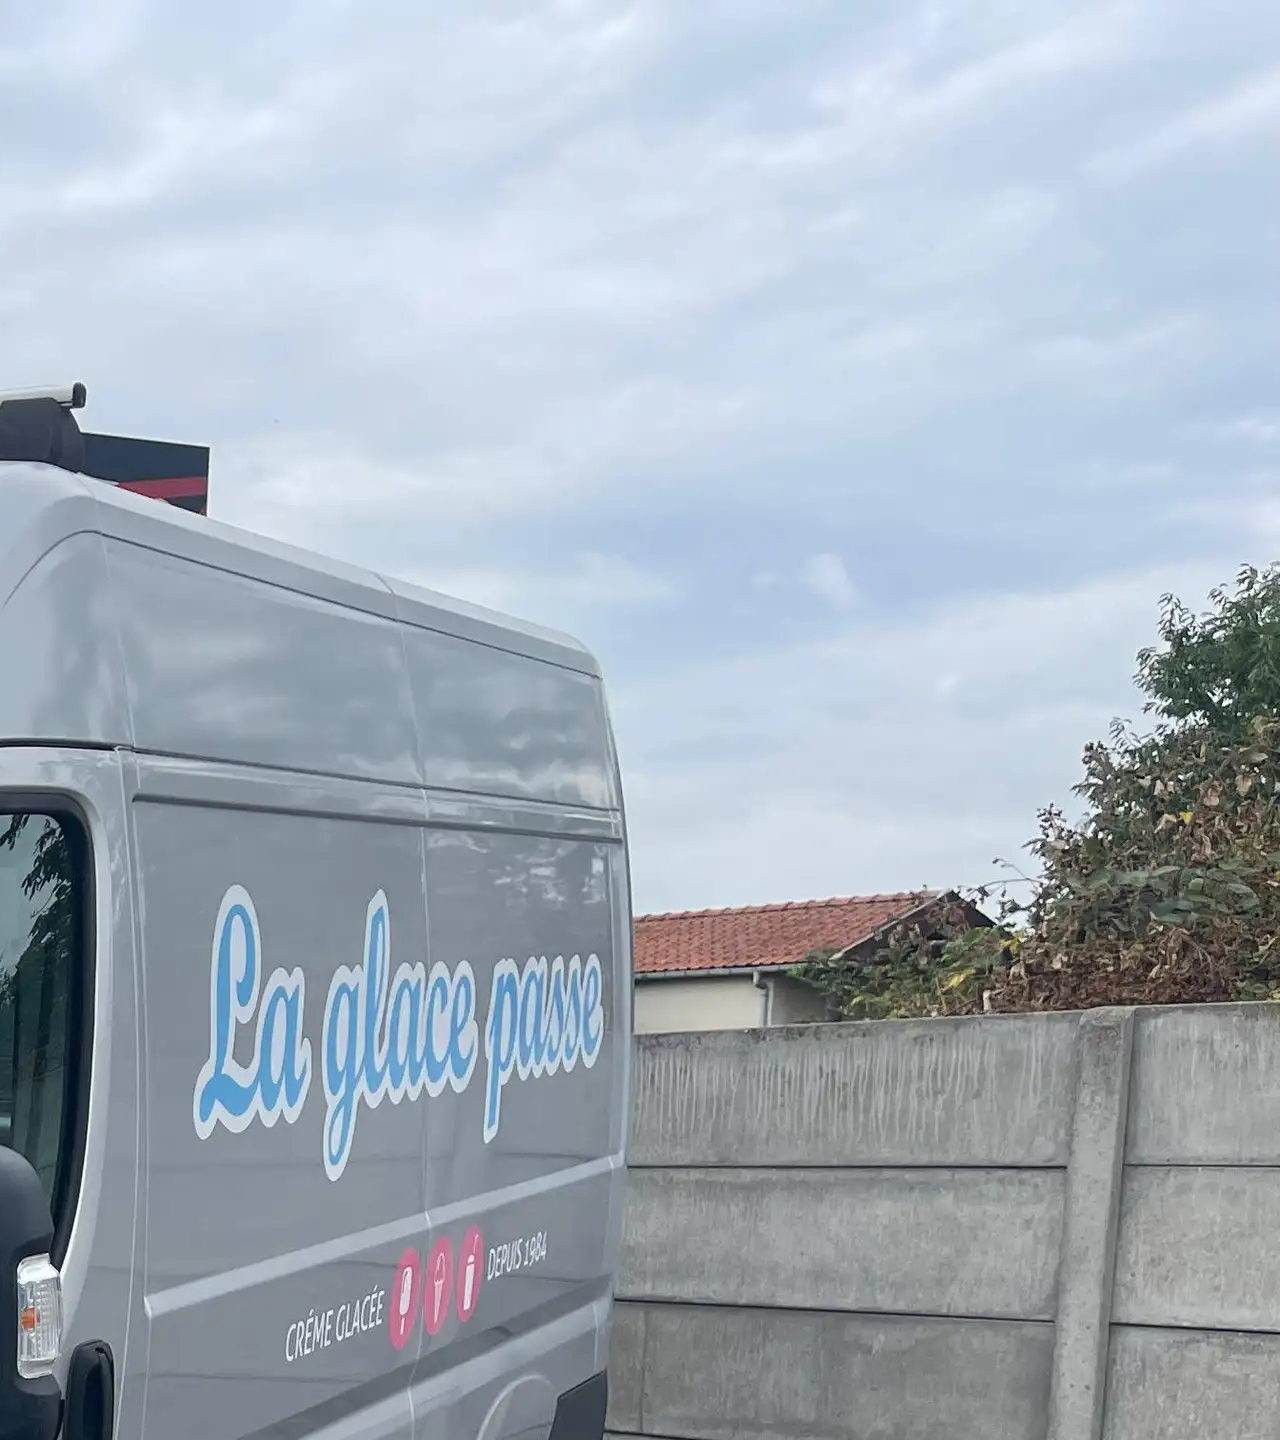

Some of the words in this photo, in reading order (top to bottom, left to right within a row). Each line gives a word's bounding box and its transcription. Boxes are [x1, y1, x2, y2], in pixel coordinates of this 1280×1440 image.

[193, 883, 312, 1140] La
[322, 888, 479, 1182] glace
[483, 952, 606, 1144] passe
[486, 1243, 524, 1281] DEPUIS
[523, 1230, 548, 1271] 1984
[335, 1284, 386, 1343] GLACÉE
